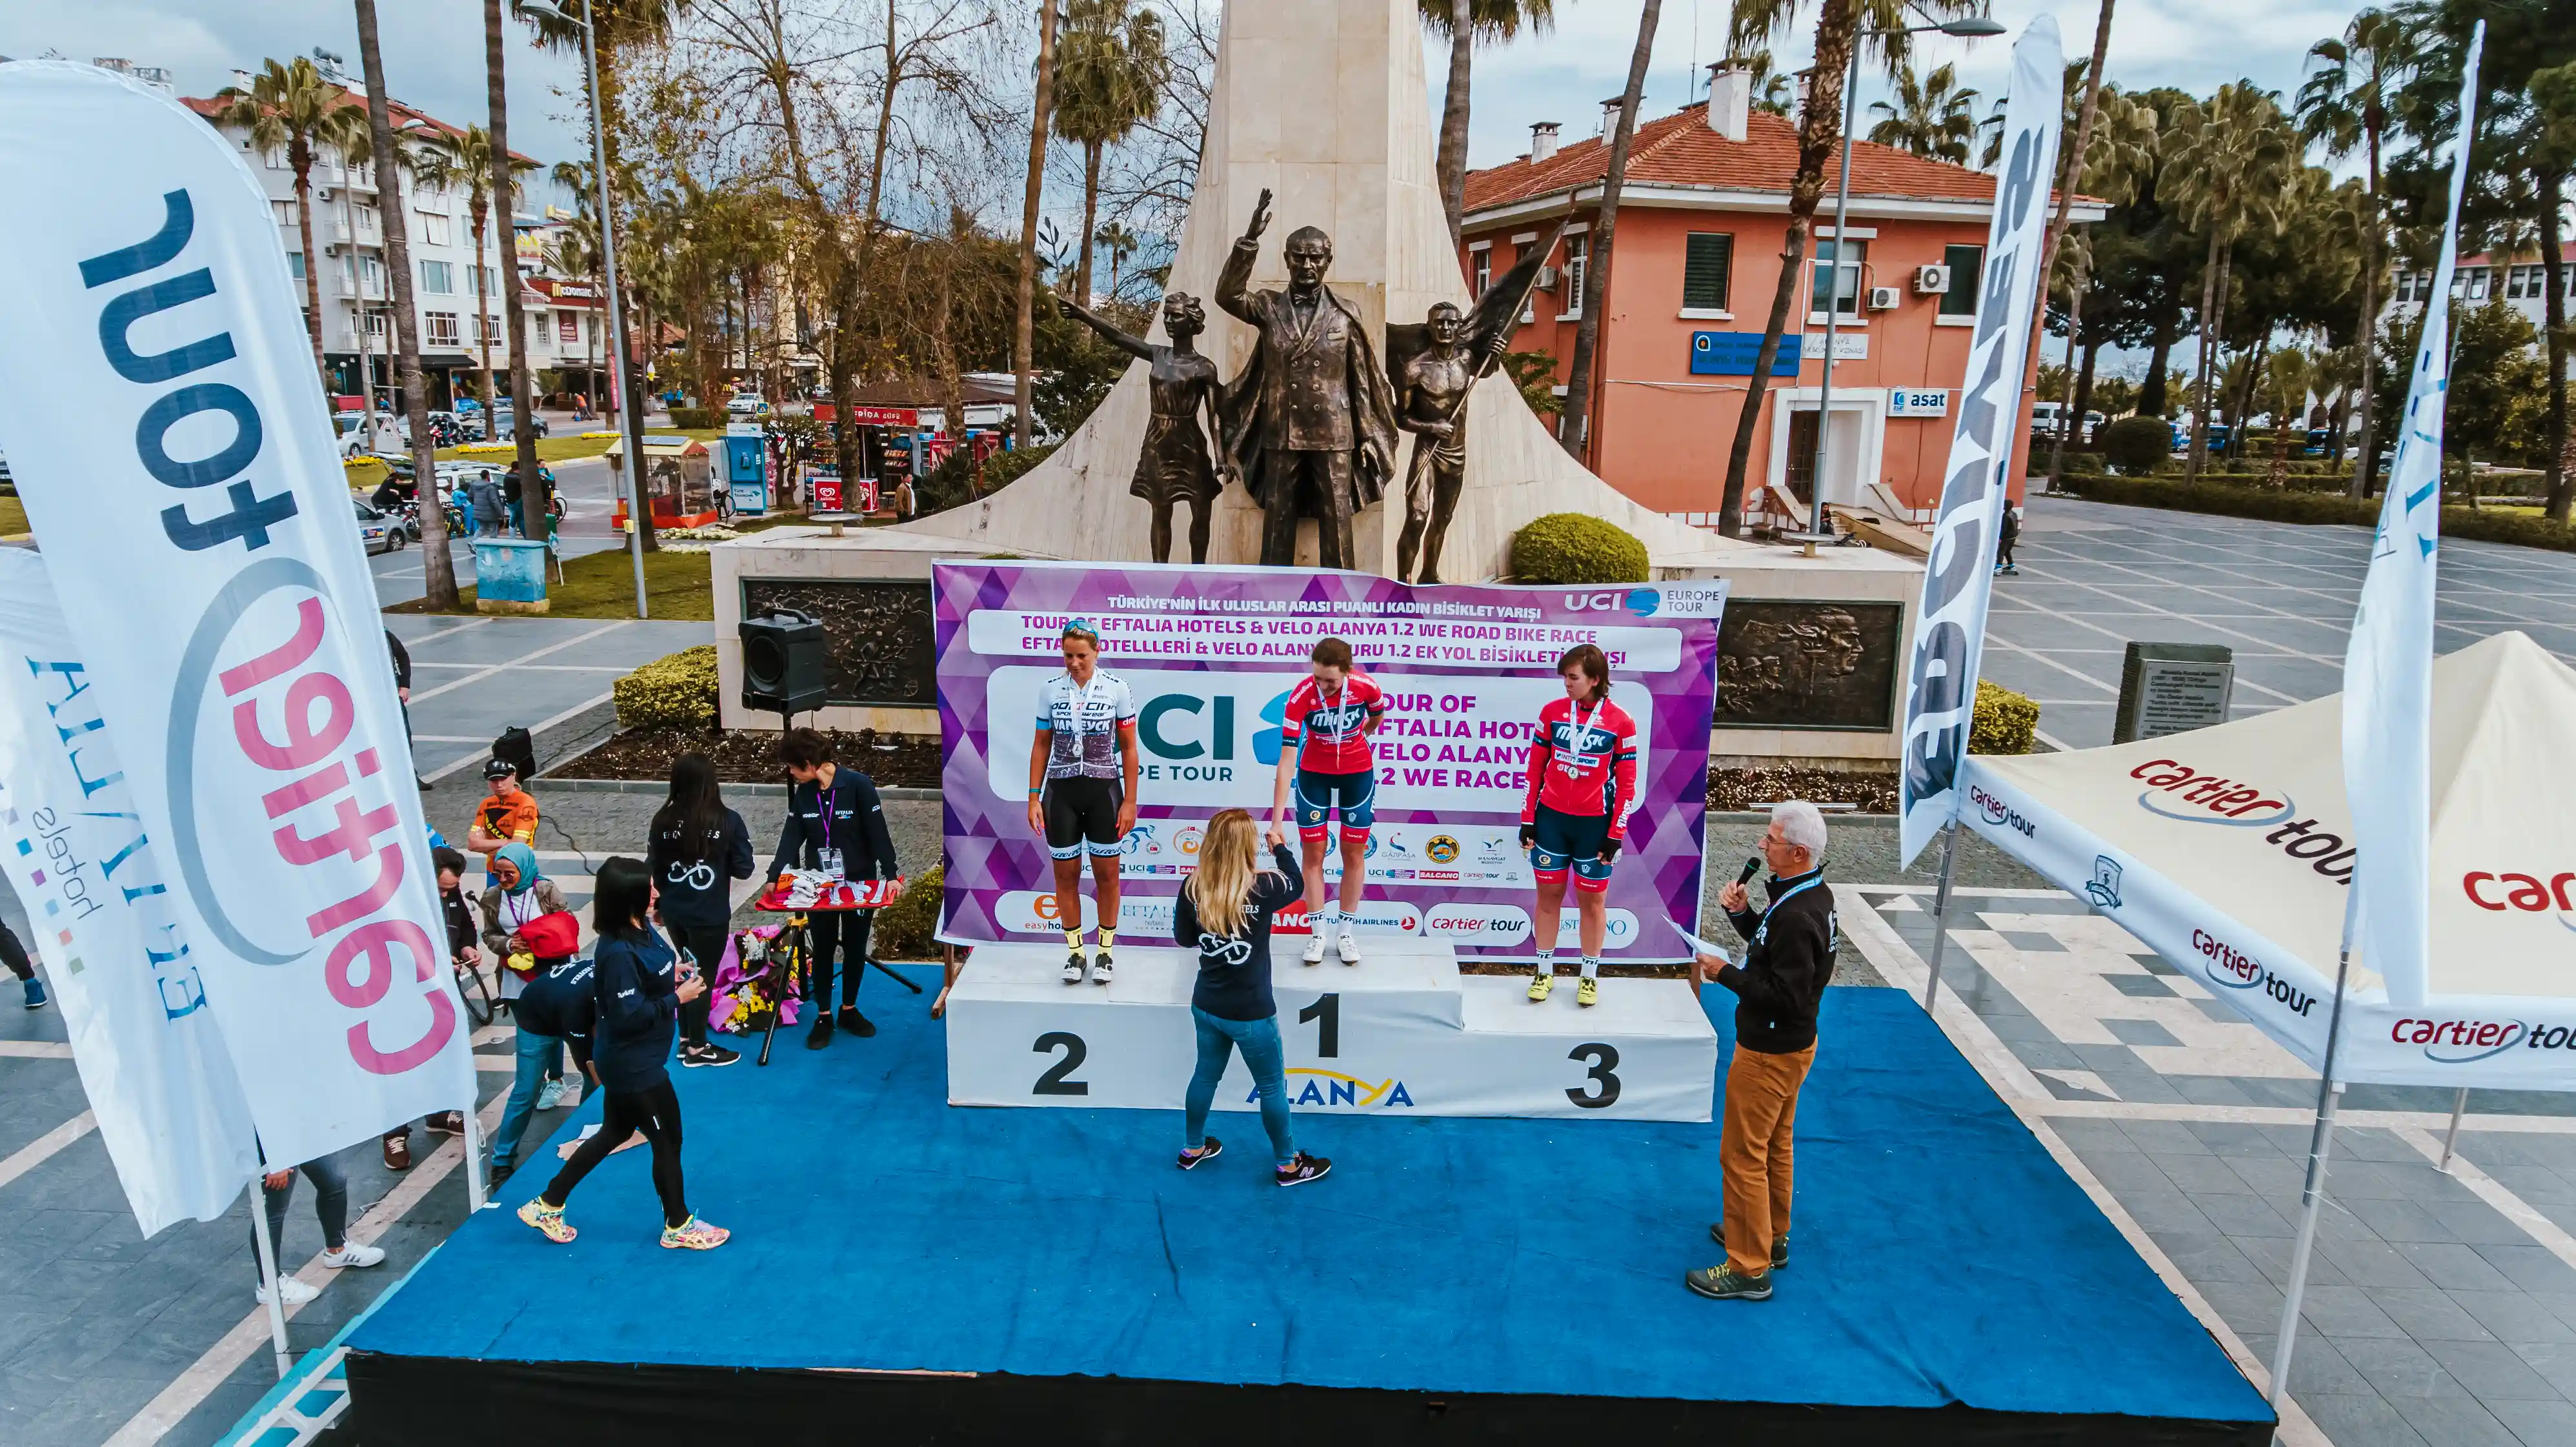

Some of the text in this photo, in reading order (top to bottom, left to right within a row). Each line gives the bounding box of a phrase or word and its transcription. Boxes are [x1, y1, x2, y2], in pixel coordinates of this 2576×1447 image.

[1911, 393, 1945, 407] asat
[1564, 592, 1621, 611] UCI
[1667, 590, 1720, 602] EUROPE
[1667, 601, 1702, 612] TOUR
[1198, 596, 1221, 611] İLK
[1223, 600, 1287, 612] ULUSLAR
[1289, 601, 1331, 613] ARASI
[1333, 602, 1384, 614] PUANLI
[1387, 602, 1431, 615] KADIN
[1496, 606, 1541, 623] YARIŞI
[1102, 617, 1174, 632] EFTALIA
[1177, 619, 1246, 634] HOTELS
[1251, 622, 1263, 634] &
[1267, 622, 1313, 635] VELO
[1316, 622, 1387, 636] ALANYA
[1391, 622, 1414, 636] 1.2
[1420, 623, 1447, 638] WE
[1452, 625, 1500, 641] ROAD
[1505, 628, 1545, 642] BIKE
[1550, 629, 1597, 644] RACE
[1022, 636, 1063, 651] EFTA
[1098, 637, 1191, 654] OTELLLERİ
[1196, 642, 1208, 654] &
[1214, 642, 1258, 656] VELO
[1261, 643, 1316, 656] ALANY
[1351, 643, 1384, 657] URU
[1388, 643, 1411, 658] 1.2
[1416, 645, 1438, 660] EK
[1442, 646, 1475, 662] YOL
[1383, 693, 1476, 713] OUR OF
[1118, 694, 1234, 760] CI
[1371, 718, 1535, 740] FTALIA HOT
[1437, 744, 1531, 765] ALANY
[1169, 765, 1233, 782] TOUR
[1374, 767, 1527, 789] .2 WE RACE
[1970, 785, 2036, 839] cartier tour
[2130, 759, 2358, 885] cartier tou
[1420, 871, 1459, 880] SALCANO
[1025, 920, 1062, 931] easyho
[1363, 918, 1399, 926] AIRLINES
[1432, 917, 1525, 931] cartier tour
[2193, 928, 2317, 1017] cartier tour
[1299, 993, 1339, 1058] 1
[2391, 1018, 2519, 1047] cartier
[1032, 1031, 1089, 1096] 2
[1565, 1042, 1622, 1109] 3
